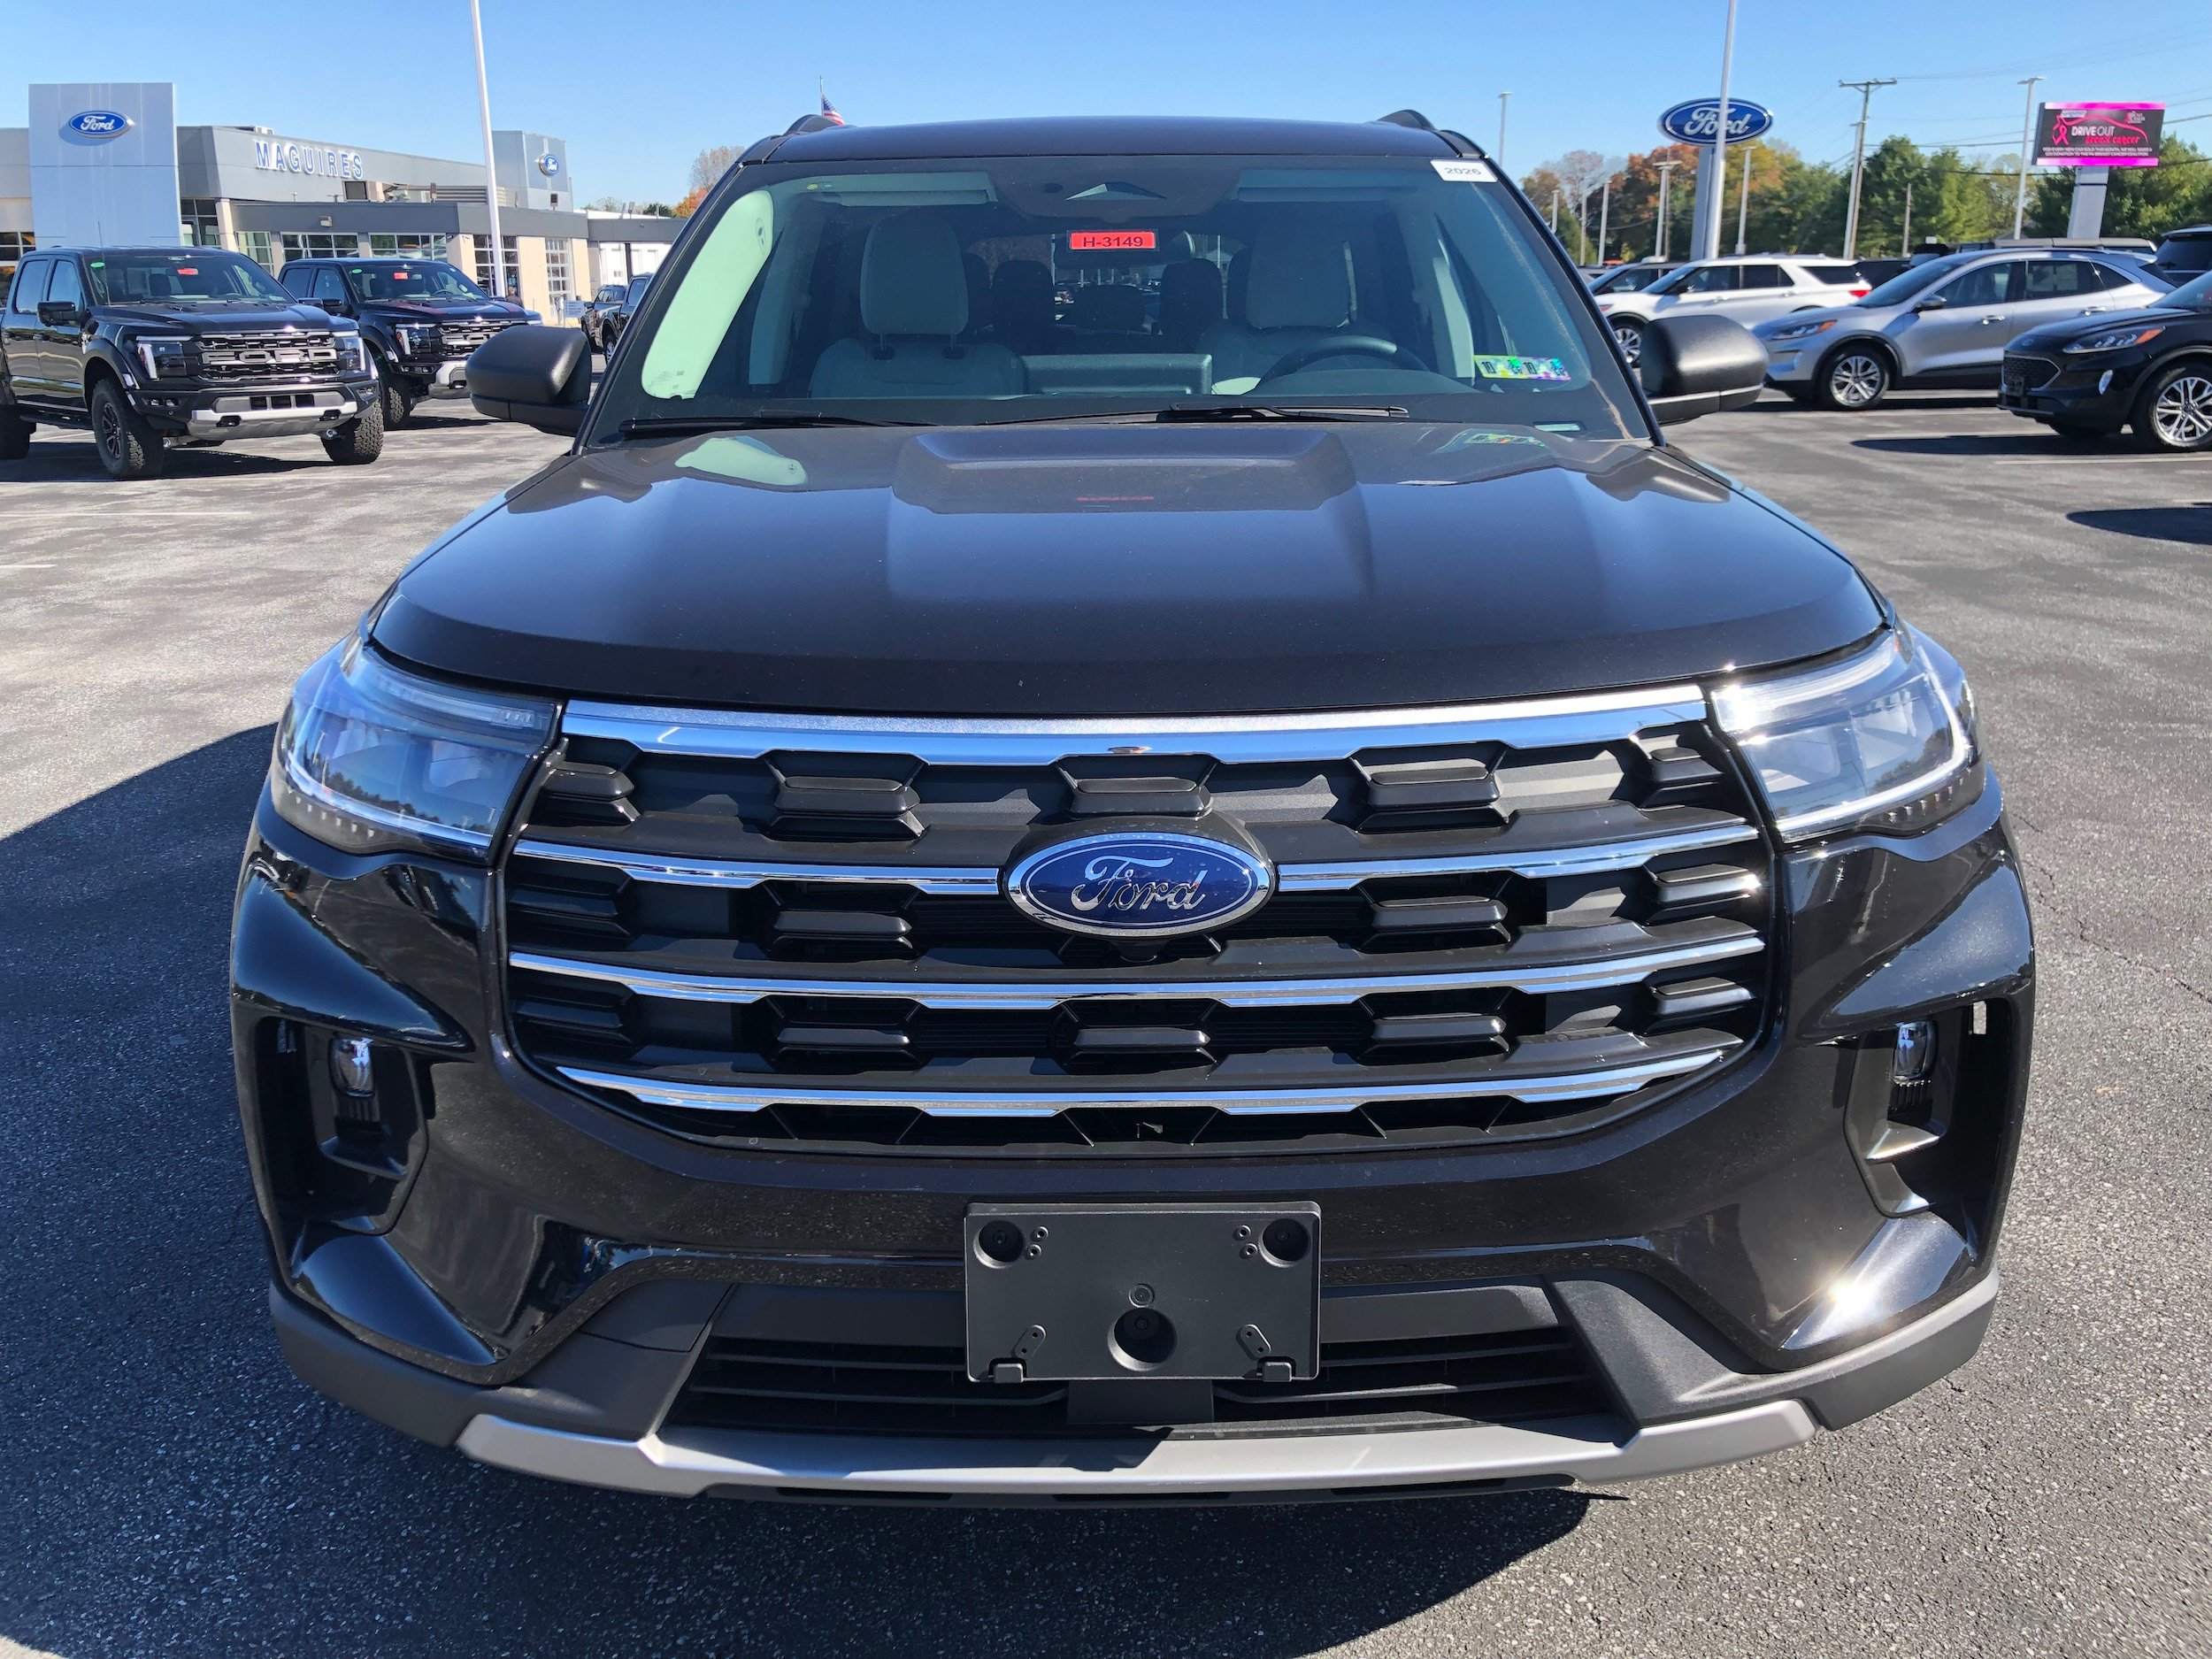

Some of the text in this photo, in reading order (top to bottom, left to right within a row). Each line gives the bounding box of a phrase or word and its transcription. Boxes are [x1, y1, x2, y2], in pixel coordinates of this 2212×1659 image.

[80, 115, 115, 131] Ford
[2071, 126, 2116, 136] DRIVE OUT
[254, 141, 363, 180] MAGUIRES
[1083, 236, 1143, 248] H-3149
[202, 349, 338, 365] FORD
[1071, 855, 1208, 911] Ford
